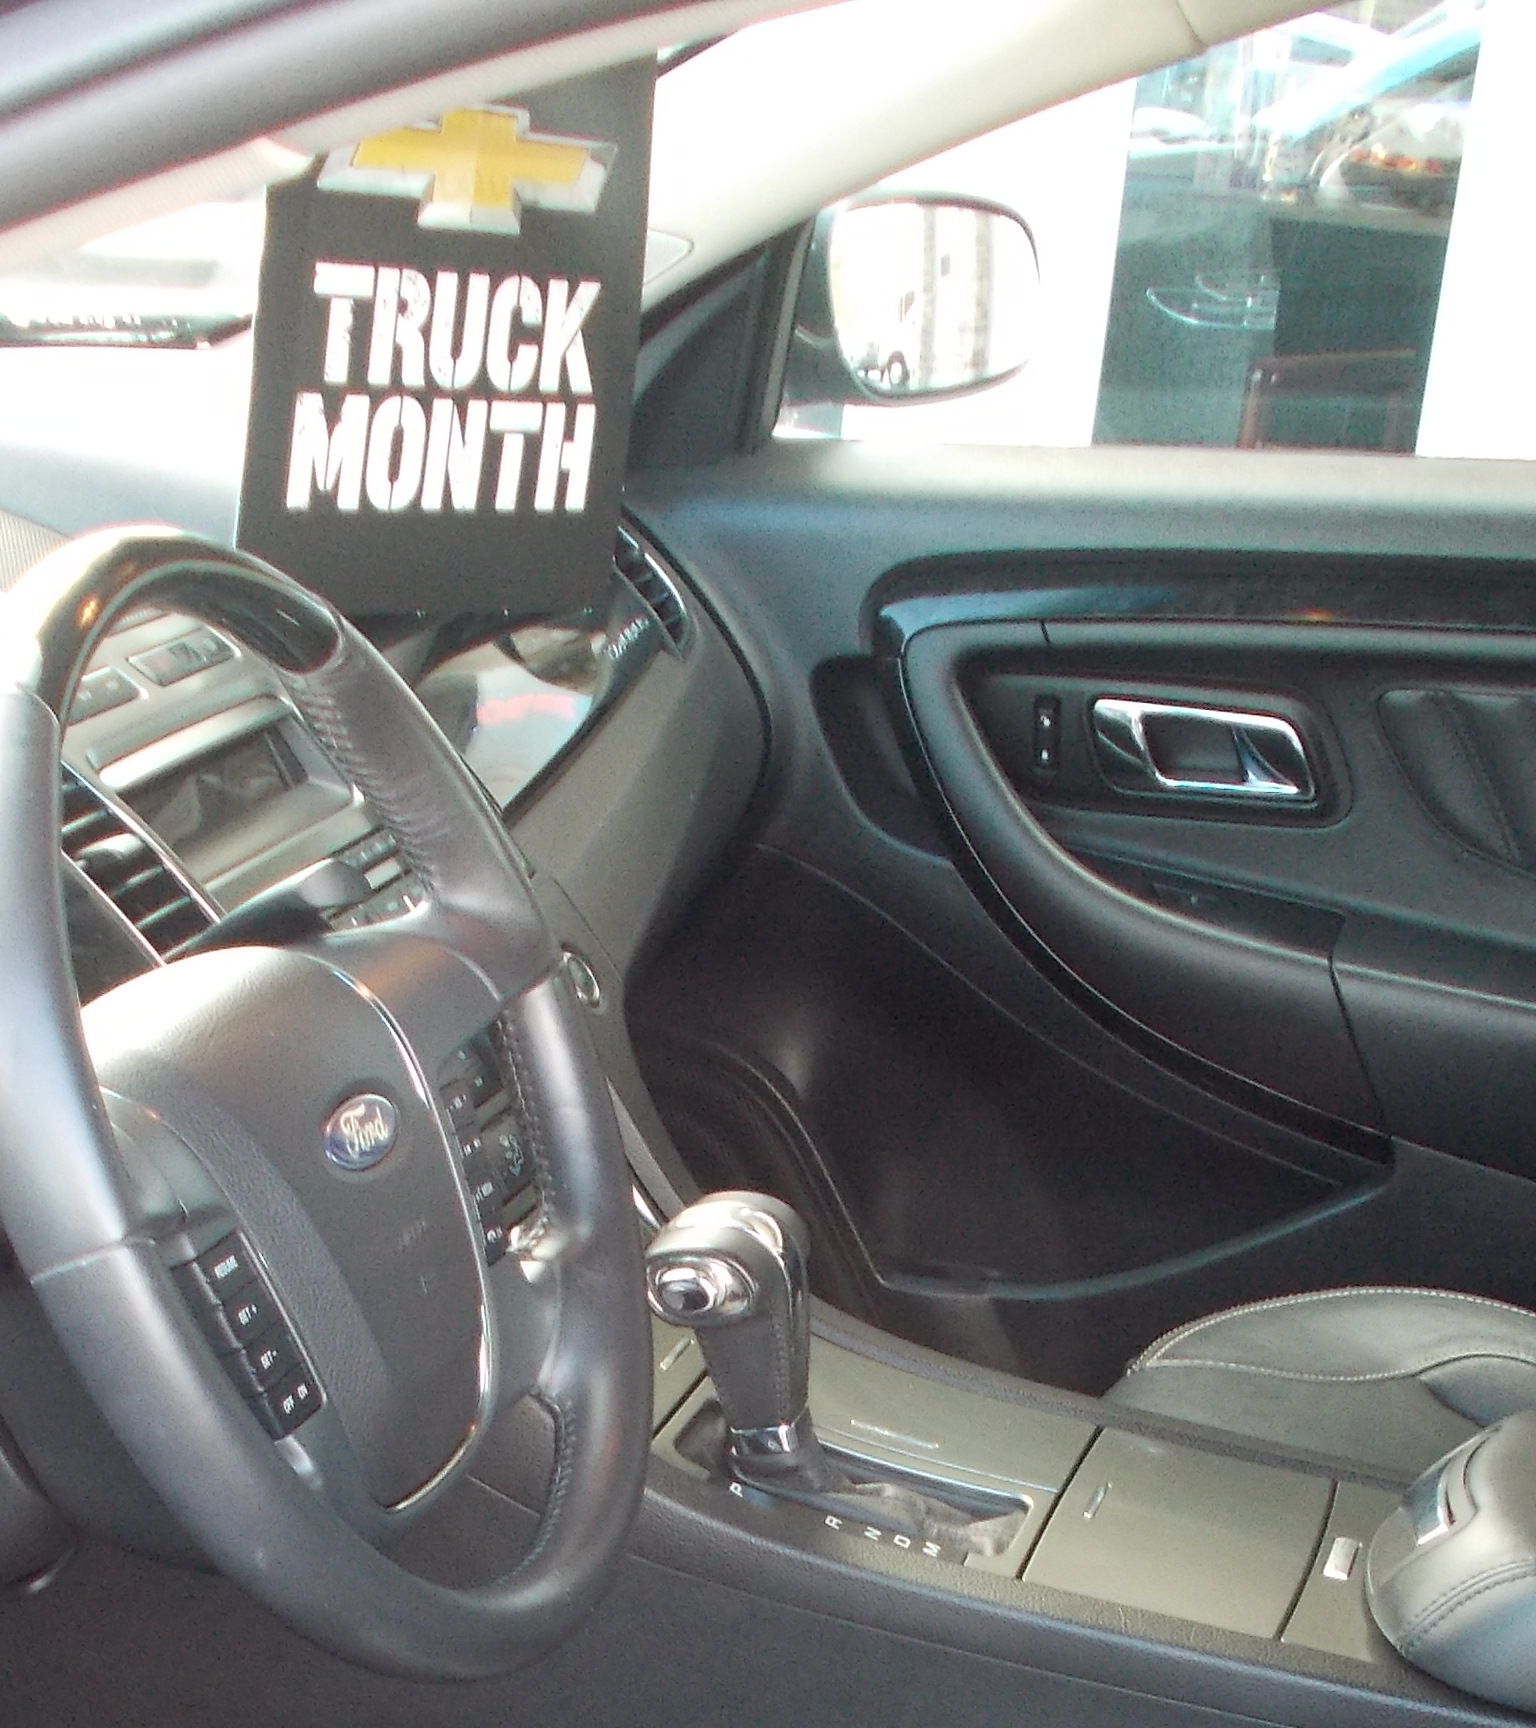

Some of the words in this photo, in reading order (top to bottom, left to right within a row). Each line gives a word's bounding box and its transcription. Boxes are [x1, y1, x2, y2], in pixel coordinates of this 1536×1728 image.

[313, 261, 602, 393] TRUCK
[285, 391, 596, 513] MONTH
[339, 1102, 390, 1160] Ford
[729, 1481, 744, 1498] P
[824, 1514, 843, 1531] R
[864, 1526, 882, 1542] N
[893, 1534, 912, 1549] D
[922, 1541, 942, 1558] M
